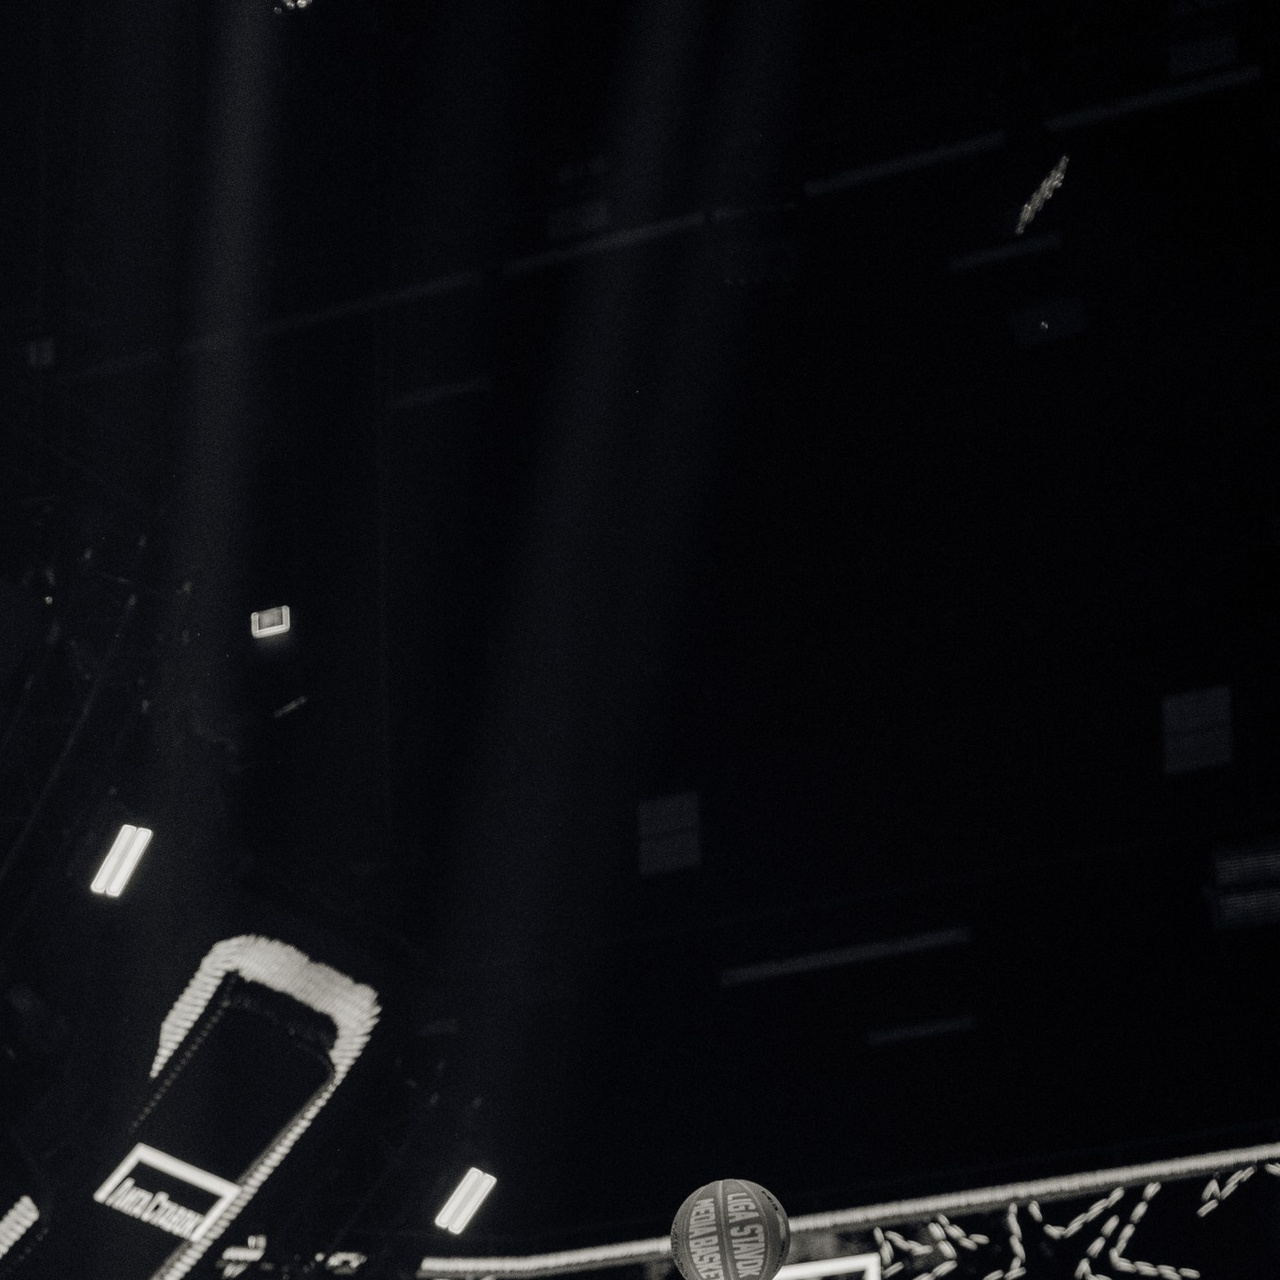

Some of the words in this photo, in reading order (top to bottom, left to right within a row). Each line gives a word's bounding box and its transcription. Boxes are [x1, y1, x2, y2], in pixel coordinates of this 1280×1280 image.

[688, 1198, 718, 1240] MEDIA
[727, 1193, 760, 1225] LIGA
[729, 1223, 766, 1279] STAVOK
